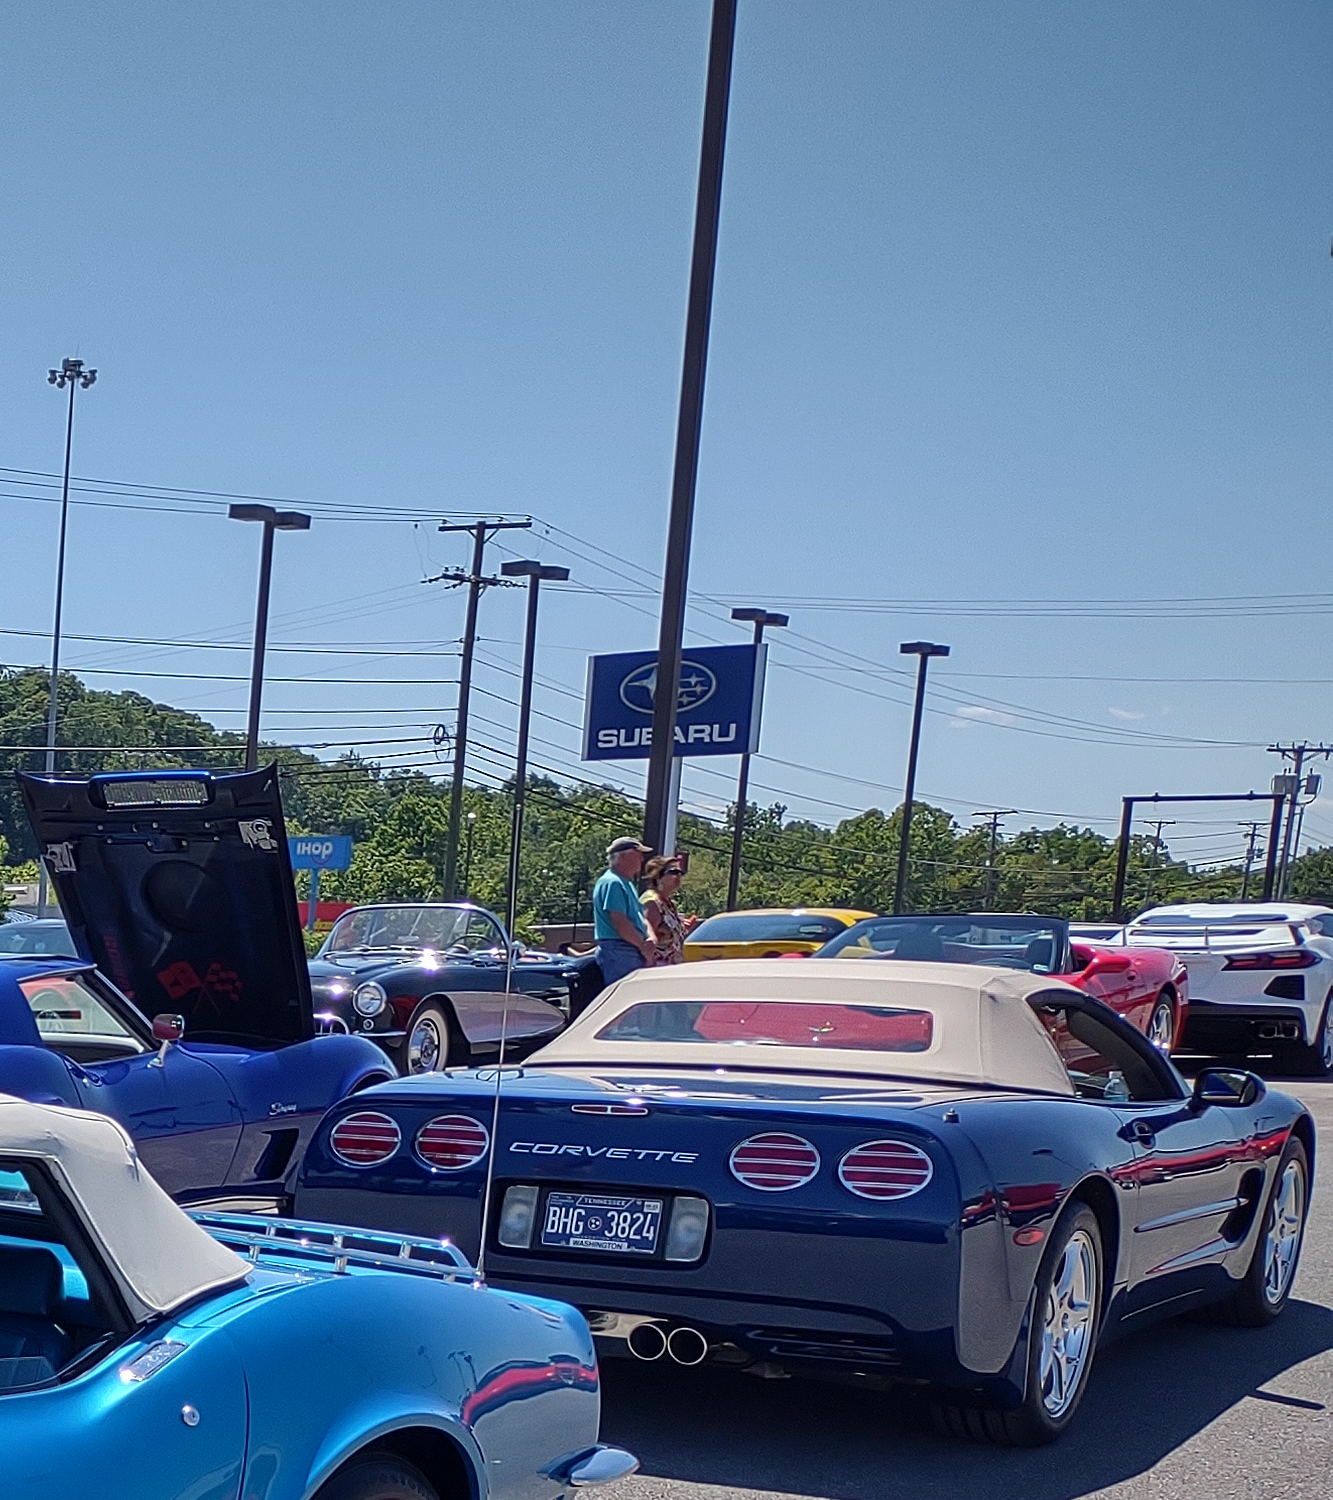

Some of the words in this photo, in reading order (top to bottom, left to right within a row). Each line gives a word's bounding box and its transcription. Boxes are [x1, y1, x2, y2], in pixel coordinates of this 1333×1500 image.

[509, 1142, 699, 1164] CORVETTE
[546, 1206, 585, 1234] BHG
[604, 1210, 654, 1241] 3824
[573, 1239, 623, 1250] WASHINGTON
